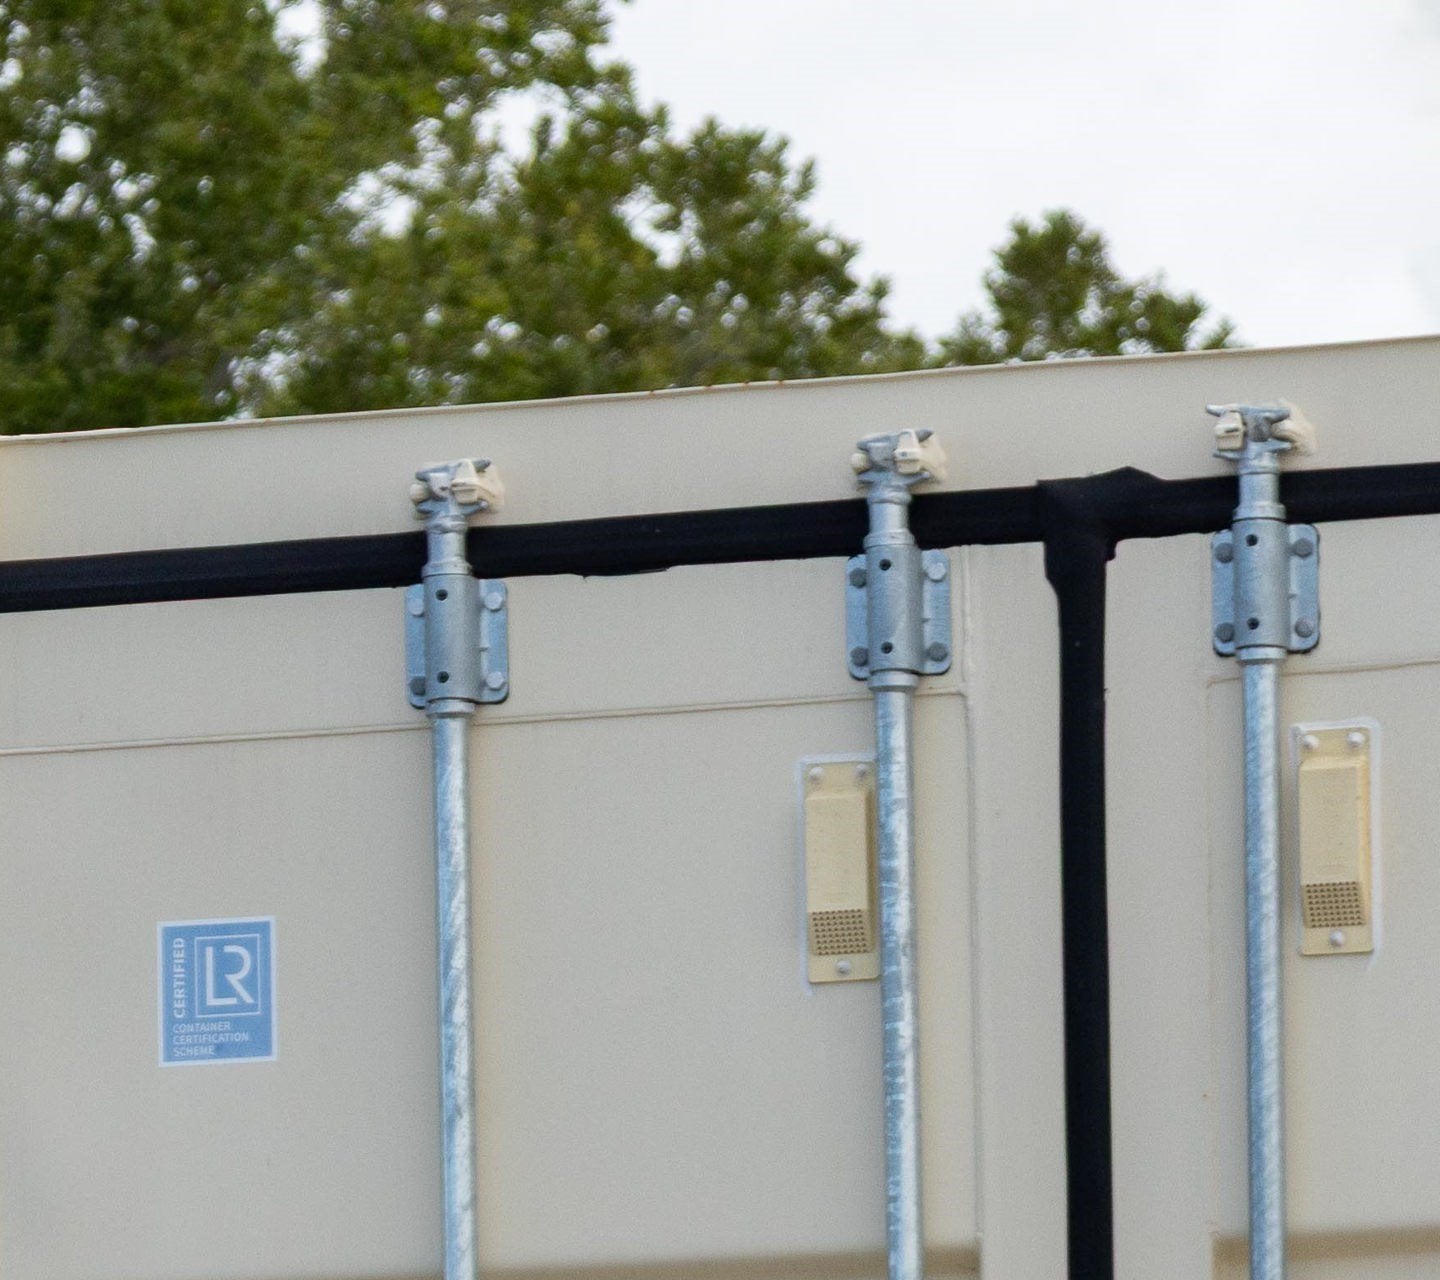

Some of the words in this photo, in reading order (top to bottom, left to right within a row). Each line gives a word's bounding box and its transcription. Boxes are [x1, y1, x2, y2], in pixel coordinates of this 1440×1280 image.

[173, 937, 186, 1018] CERTIFIED
[205, 944, 255, 1006] LR
[172, 1021, 231, 1033] CONTAINER
[172, 1032, 250, 1045] CERTIFICATION
[173, 1045, 215, 1057] SCHEME
